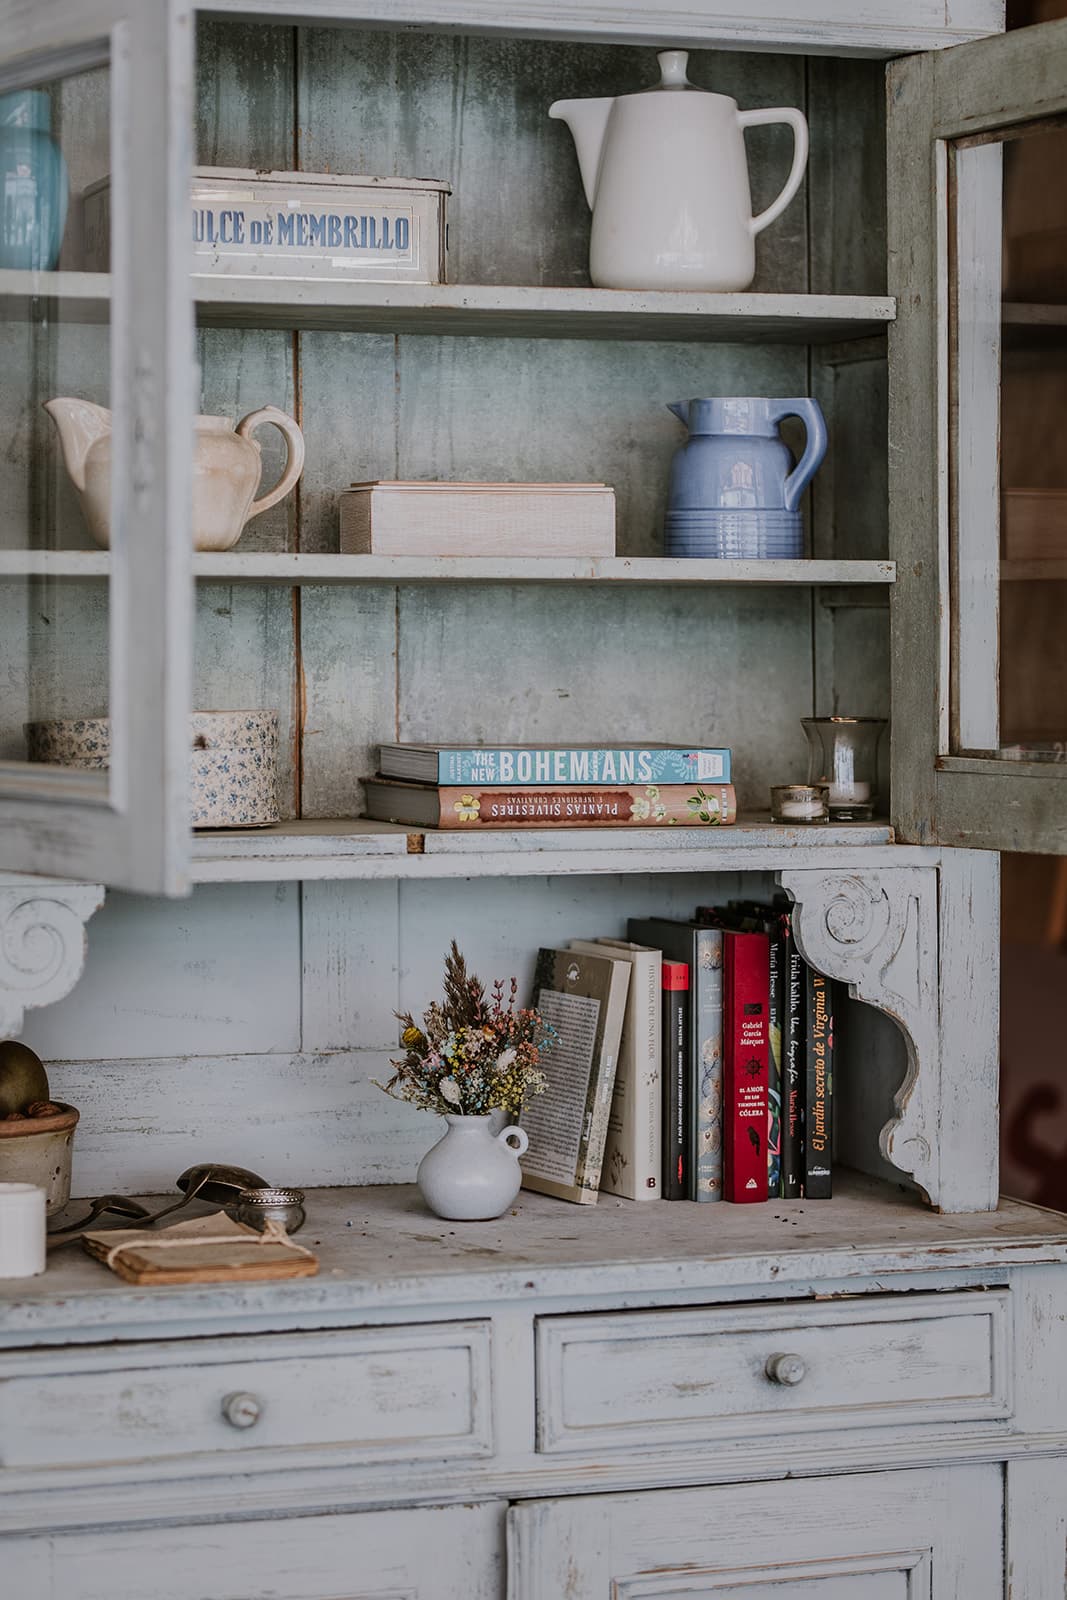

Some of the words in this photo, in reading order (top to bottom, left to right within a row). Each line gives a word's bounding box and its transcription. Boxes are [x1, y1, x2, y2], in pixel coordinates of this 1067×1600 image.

[192, 209, 245, 244] ULCE
[277, 212, 409, 250] MEMBRILLO
[474, 752, 496, 767] THE
[500, 751, 652, 782] BOHEMIANS
[471, 767, 495, 782] NEW
[551, 796, 596, 804] INFUSIONES
[566, 803, 618, 815] PLANTAS
[491, 804, 561, 817] SILVESTRES
[769, 943, 778, 969] María
[790, 954, 801, 980] Frida
[648, 964, 656, 1004] HISTORIA
[769, 970, 778, 998] Hesse
[790, 981, 800, 1013] Kahlo.
[648, 1006, 656, 1016] DE
[812, 991, 828, 1039] Virginia
[648, 1018, 656, 1037] UNA
[742, 1021, 763, 1029] Gabriel
[648, 1039, 656, 1060] FLOR
[740, 1038, 765, 1047] Márquez
[812, 1041, 825, 1053] de
[814, 1058, 825, 1098] secreto
[789, 1089, 798, 1113] María
[739, 1108, 764, 1117] CÓLERA
[812, 1100, 828, 1138] jardín
[789, 1113, 798, 1137] Hesse
[812, 1138, 825, 1152] El
[646, 1177, 657, 1189] B
